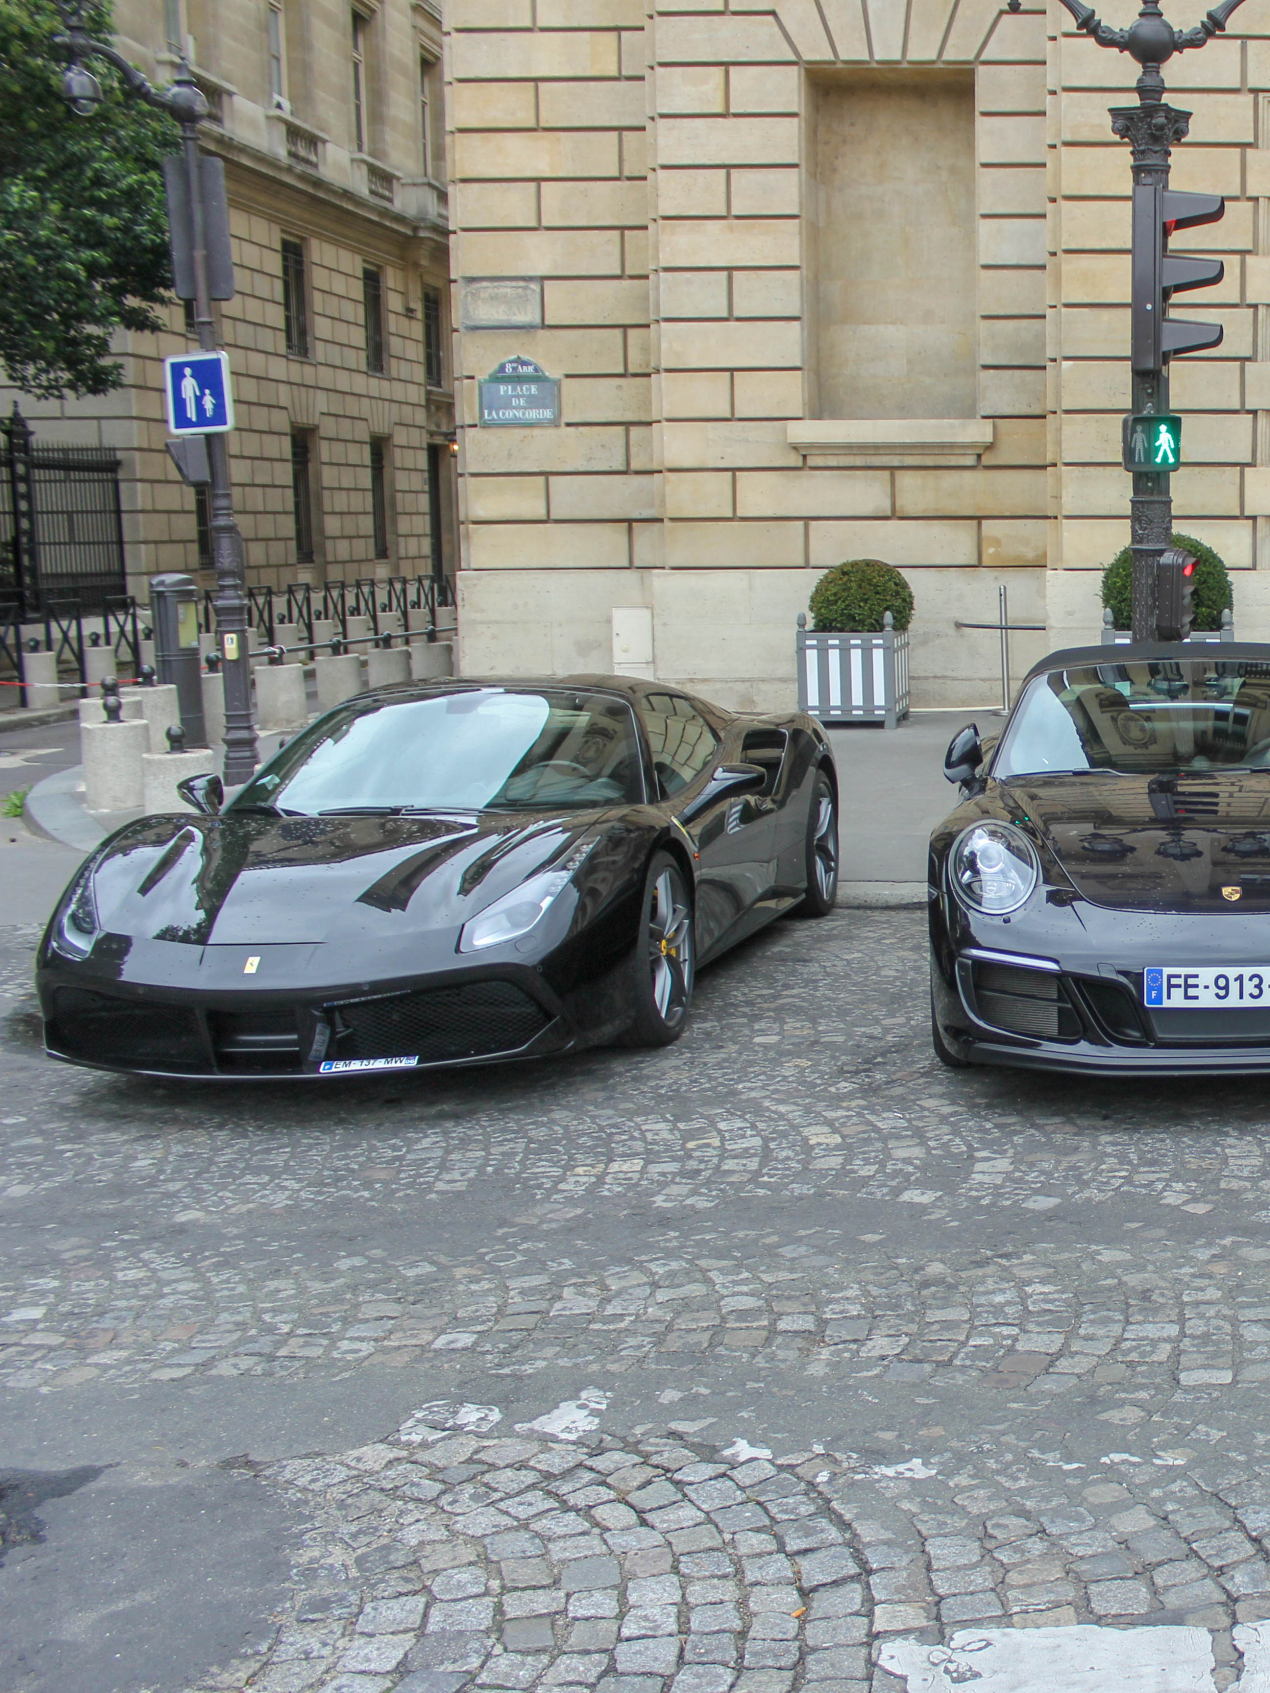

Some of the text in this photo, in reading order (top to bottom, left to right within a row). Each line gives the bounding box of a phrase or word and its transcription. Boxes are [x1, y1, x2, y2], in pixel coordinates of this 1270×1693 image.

[500, 384, 538, 395] PLACE
[511, 397, 527, 406] DE
[484, 408, 554, 420] LA CONCORDE
[1151, 990, 1158, 999] F
